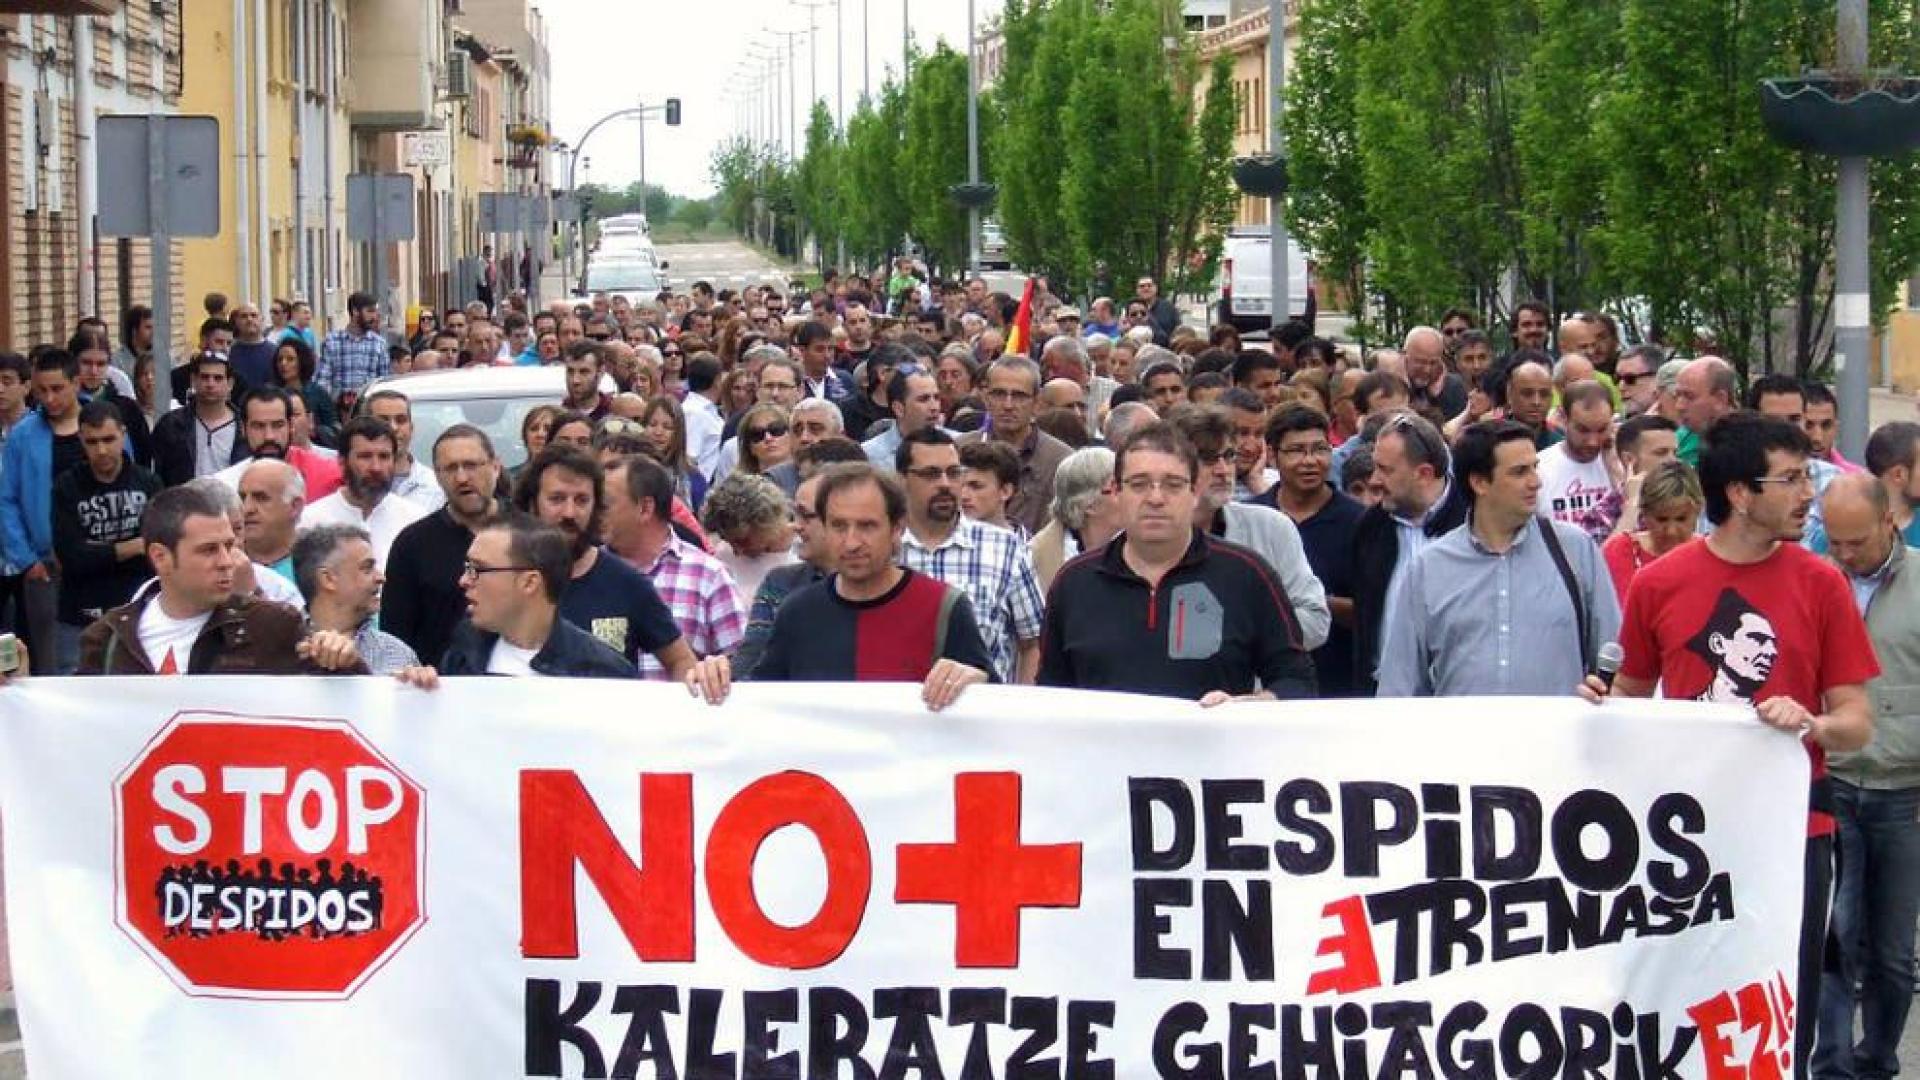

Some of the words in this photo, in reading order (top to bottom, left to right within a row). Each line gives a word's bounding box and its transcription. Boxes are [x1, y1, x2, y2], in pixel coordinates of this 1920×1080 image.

[152, 763, 404, 855] STOP
[163, 881, 374, 931] DESPIDOS
[1132, 877, 1275, 981] EN
[524, 977, 1116, 1080] KALERATZE
